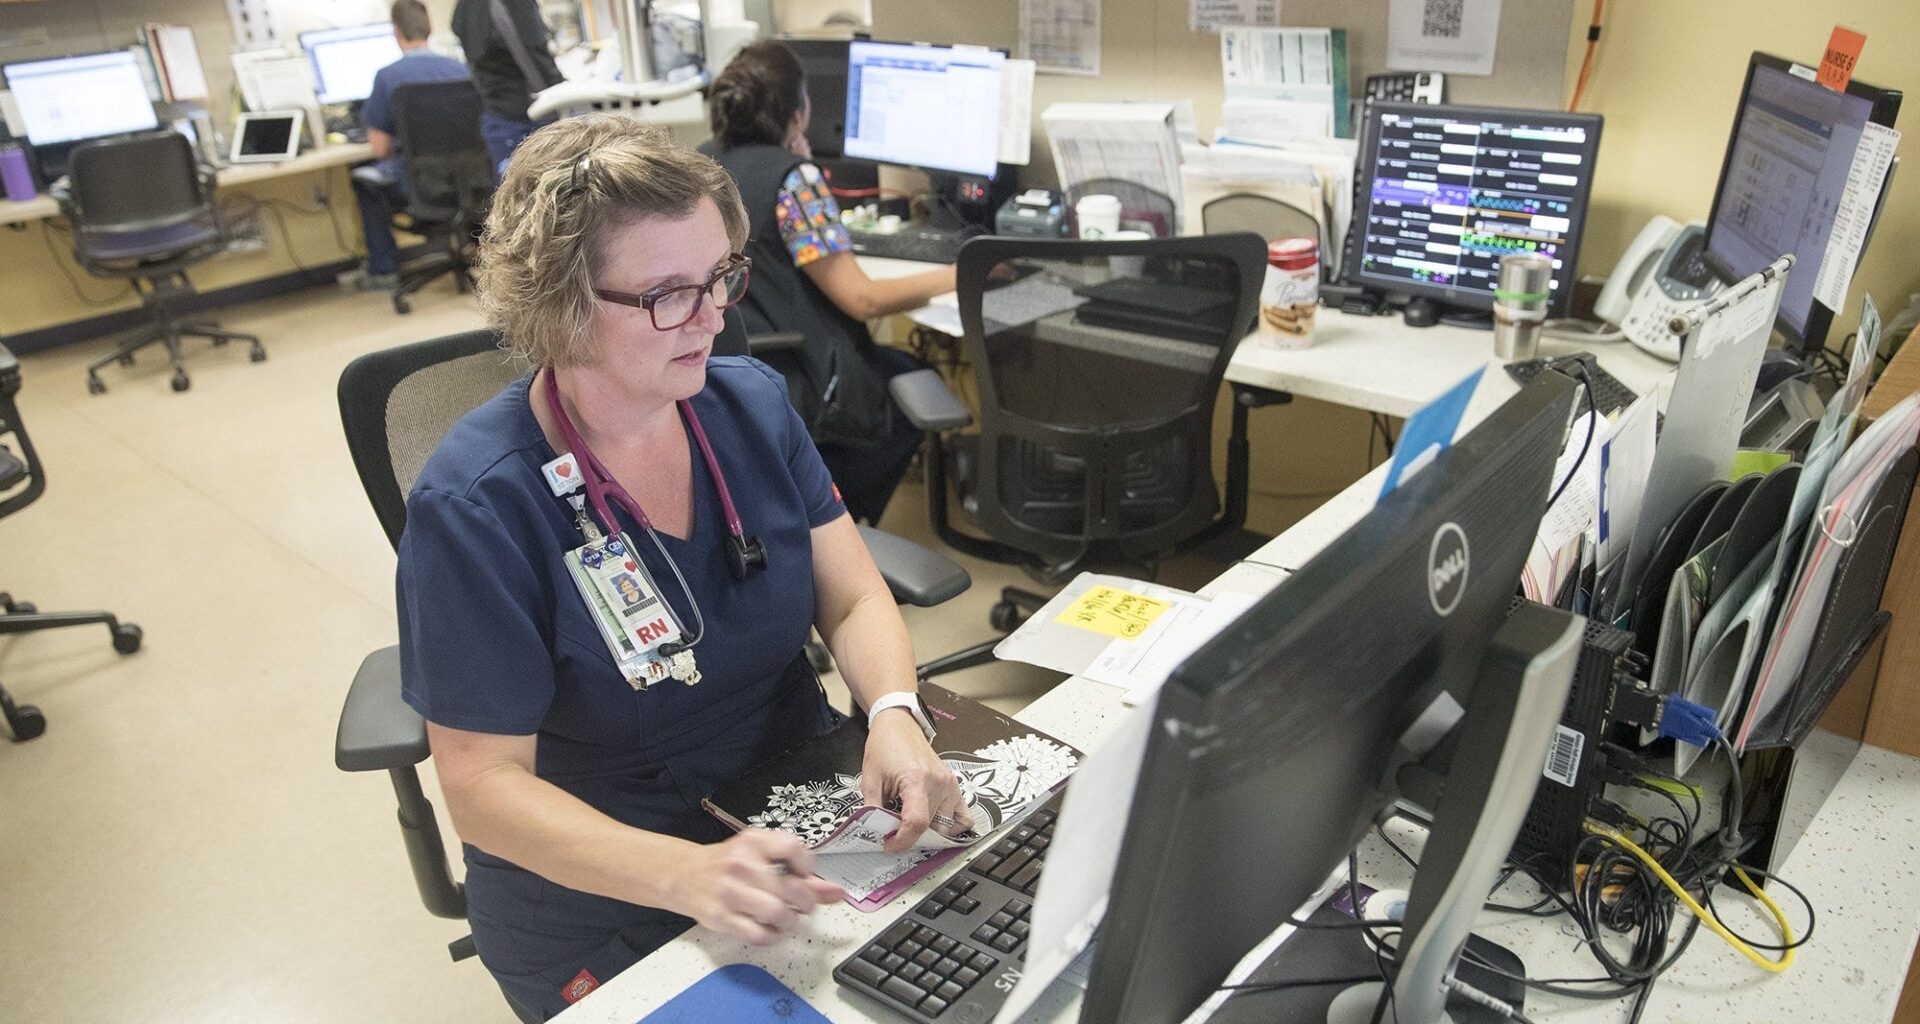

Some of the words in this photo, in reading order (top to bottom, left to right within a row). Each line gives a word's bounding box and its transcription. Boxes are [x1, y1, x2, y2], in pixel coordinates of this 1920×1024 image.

[1825, 49, 1848, 67] NURSE
[1845, 57, 1854, 71] 6
[1433, 548, 1464, 592] DELL
[636, 618, 669, 645] RN
[994, 967, 1023, 992] N5
